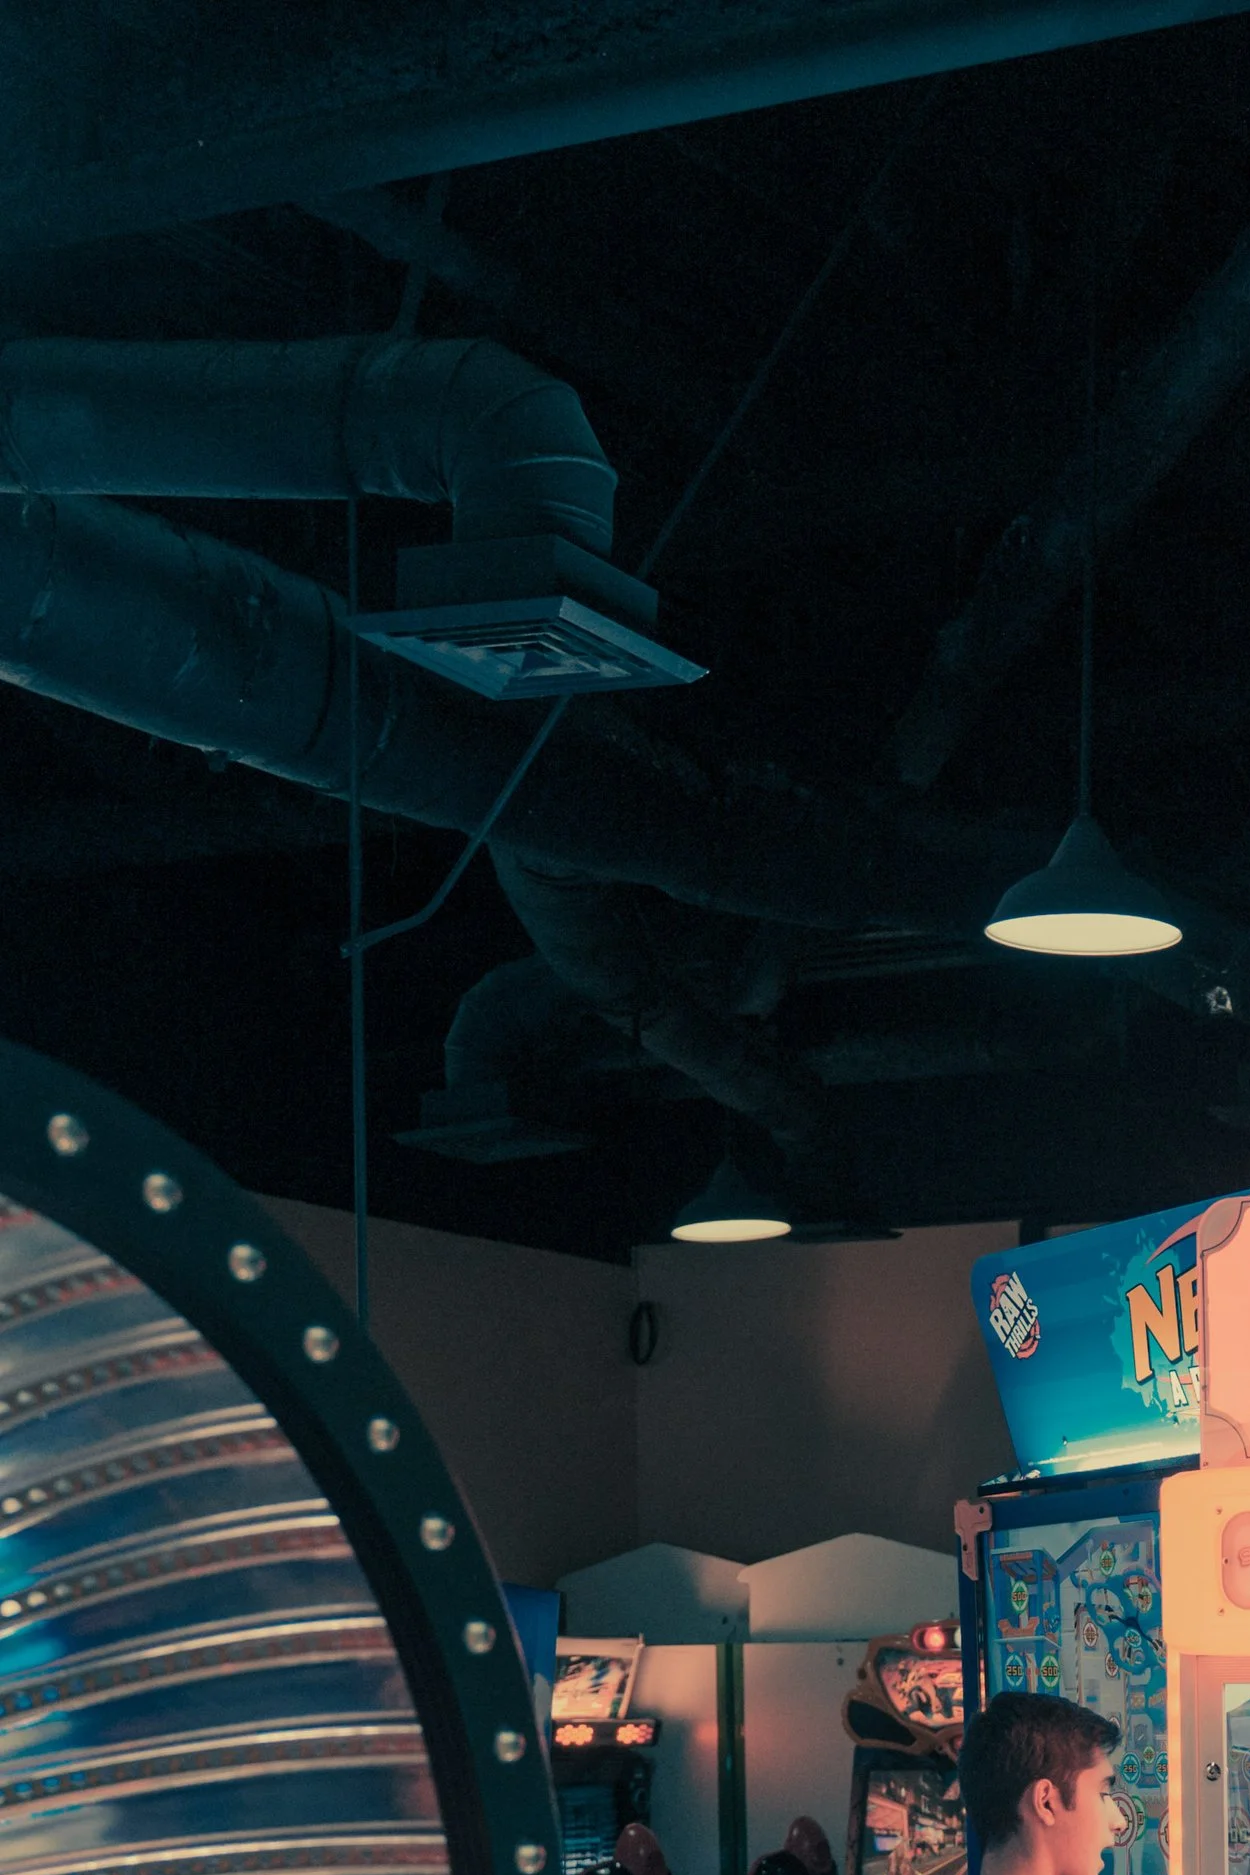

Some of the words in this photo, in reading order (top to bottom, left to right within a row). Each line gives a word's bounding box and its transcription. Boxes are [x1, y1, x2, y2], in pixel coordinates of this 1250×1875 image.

[989, 1271, 1029, 1343] RAW
[1004, 1298, 1039, 1358] THRILLS
[1007, 1665, 1023, 1675] 250
